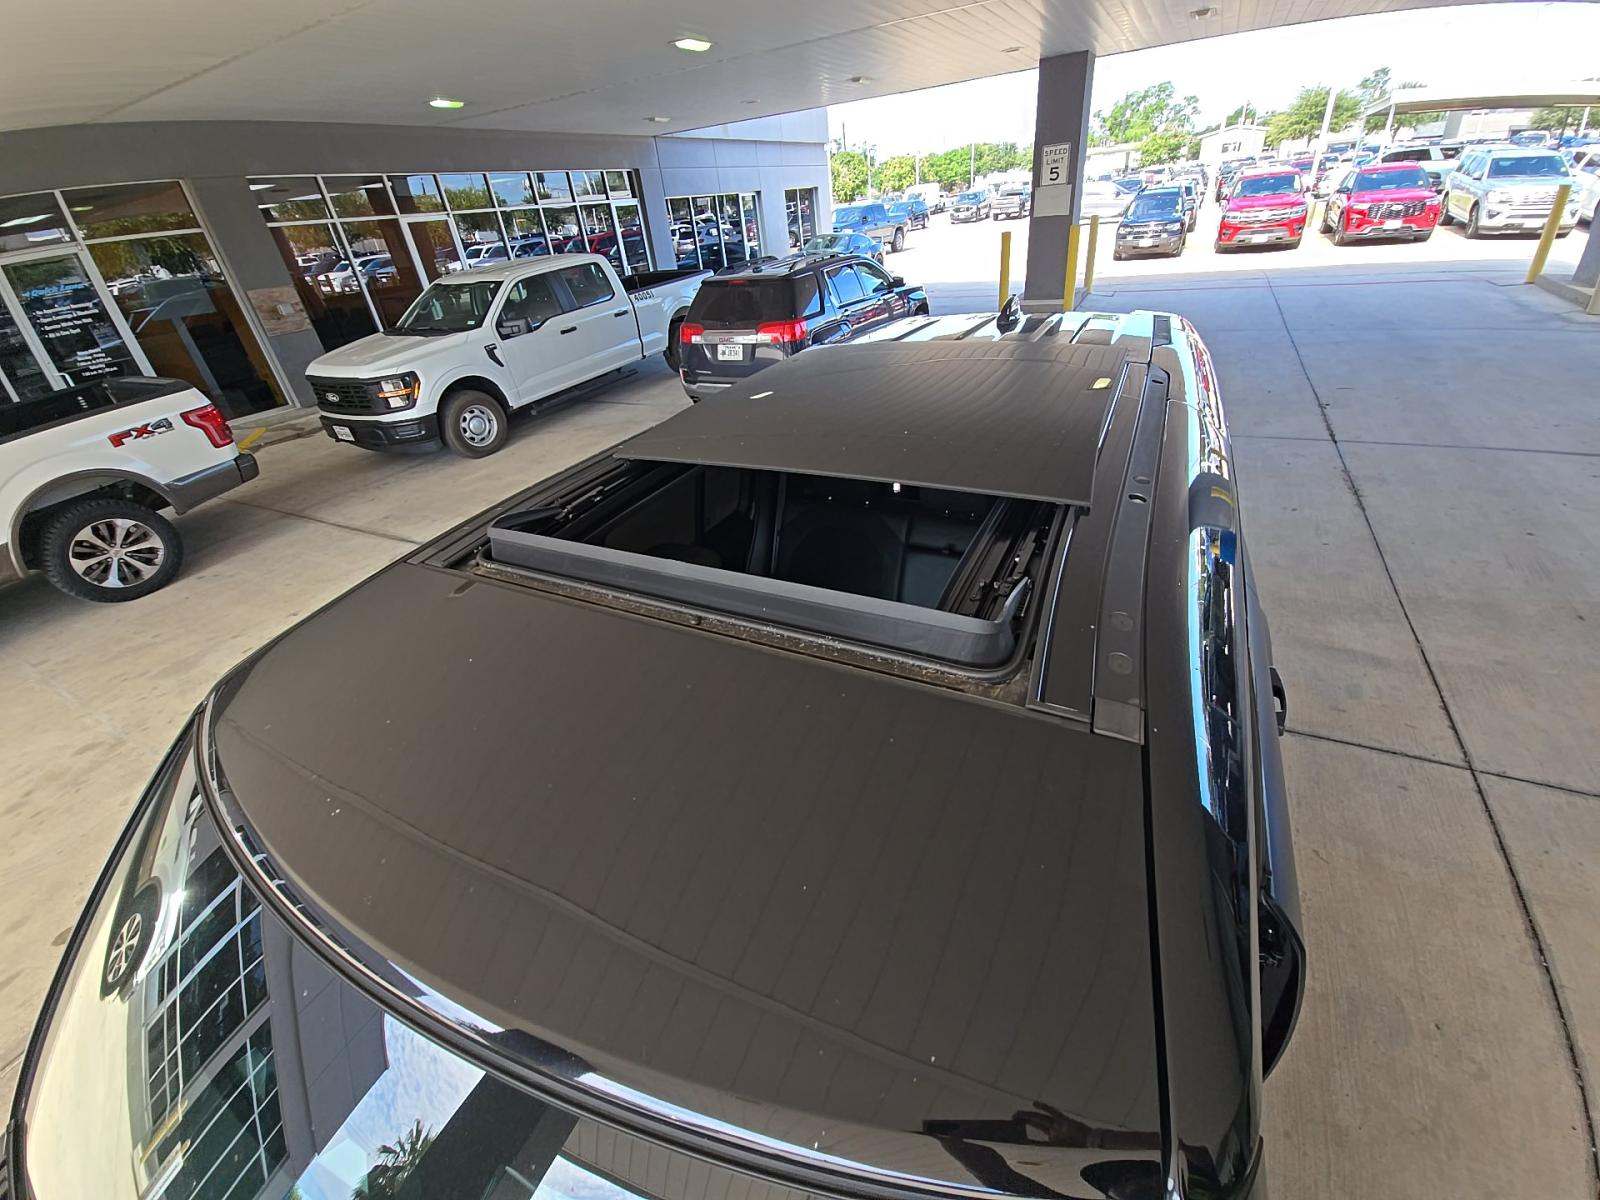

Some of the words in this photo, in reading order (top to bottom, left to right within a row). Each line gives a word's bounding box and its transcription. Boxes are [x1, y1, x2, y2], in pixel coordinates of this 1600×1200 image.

[1044, 148, 1068, 156] SPEED
[1046, 157, 1064, 165] LIMIT
[1049, 166, 1060, 181] 5
[31, 286, 59, 298] Quick
[107, 417, 174, 448] FX4
